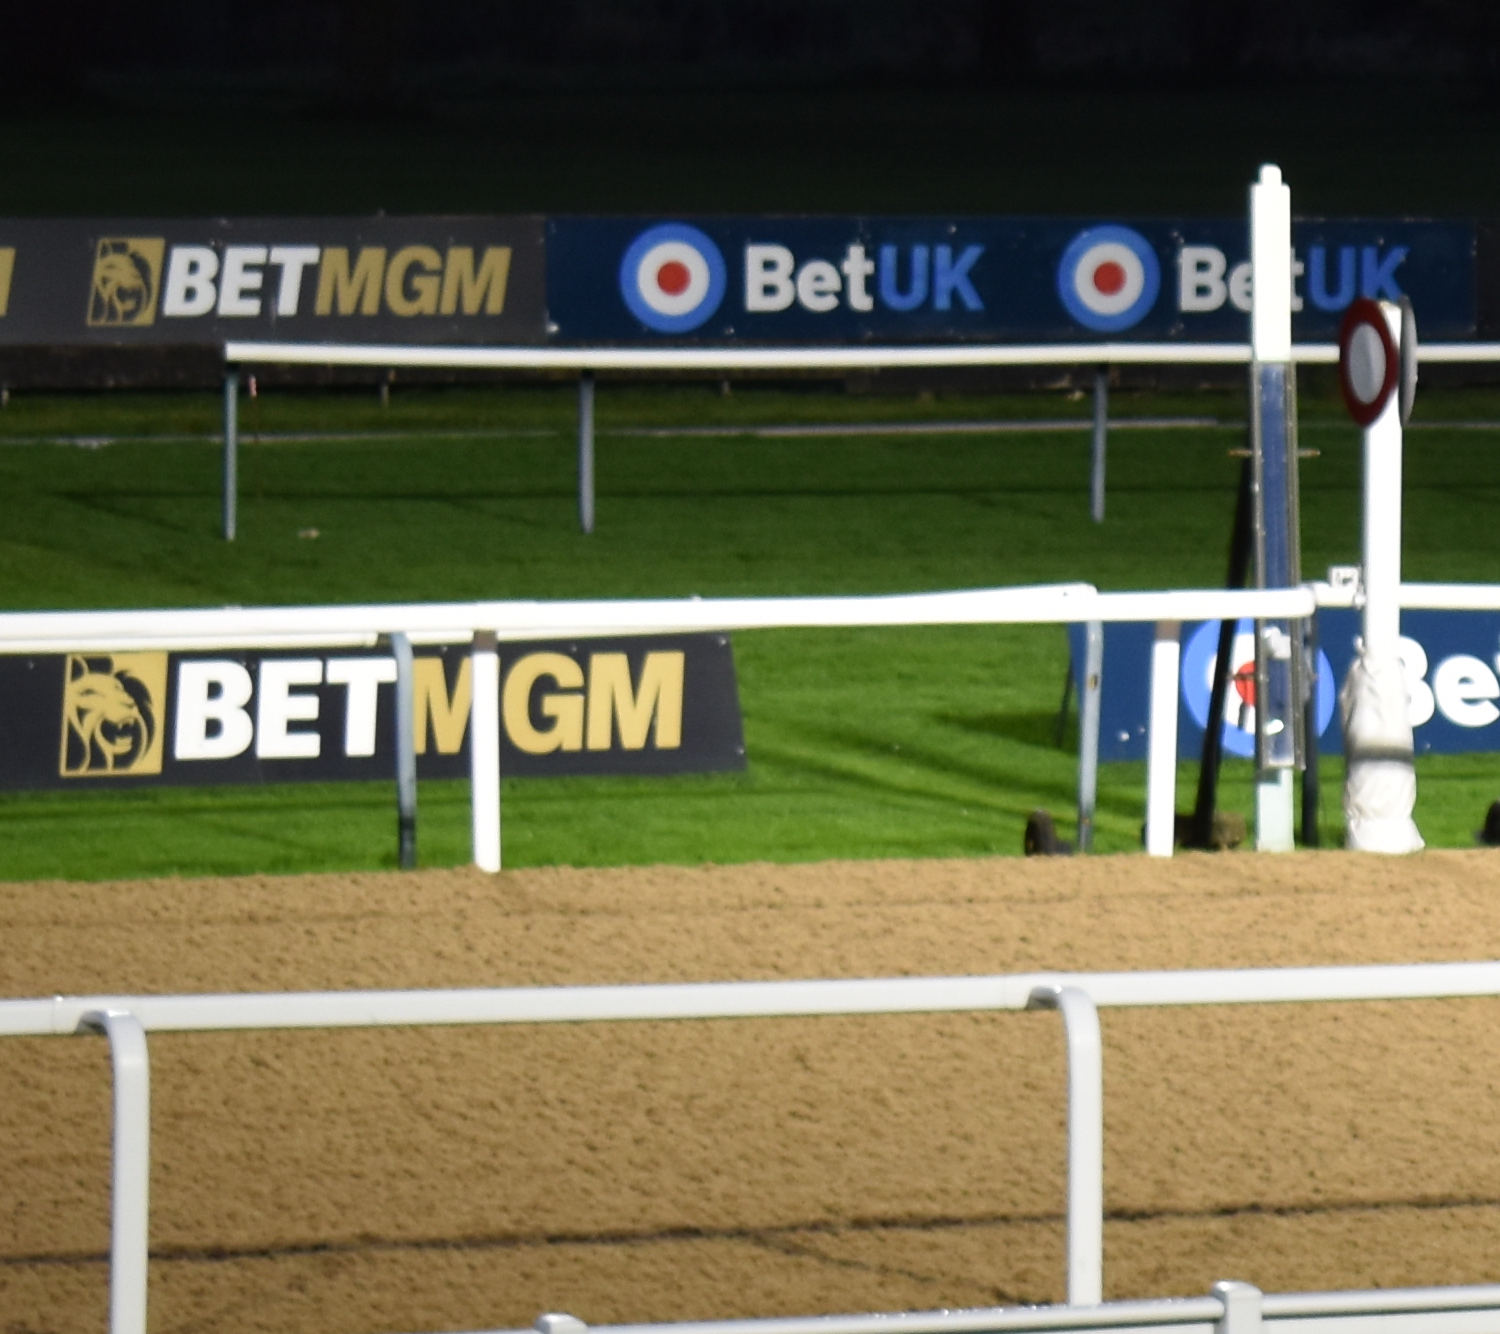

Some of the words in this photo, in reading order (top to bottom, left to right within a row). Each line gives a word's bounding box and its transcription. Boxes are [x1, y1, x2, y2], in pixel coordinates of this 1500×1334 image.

[163, 246, 511, 316] BETMGM
[745, 244, 984, 311] BetUK
[174, 652, 684, 760] BETMGM
